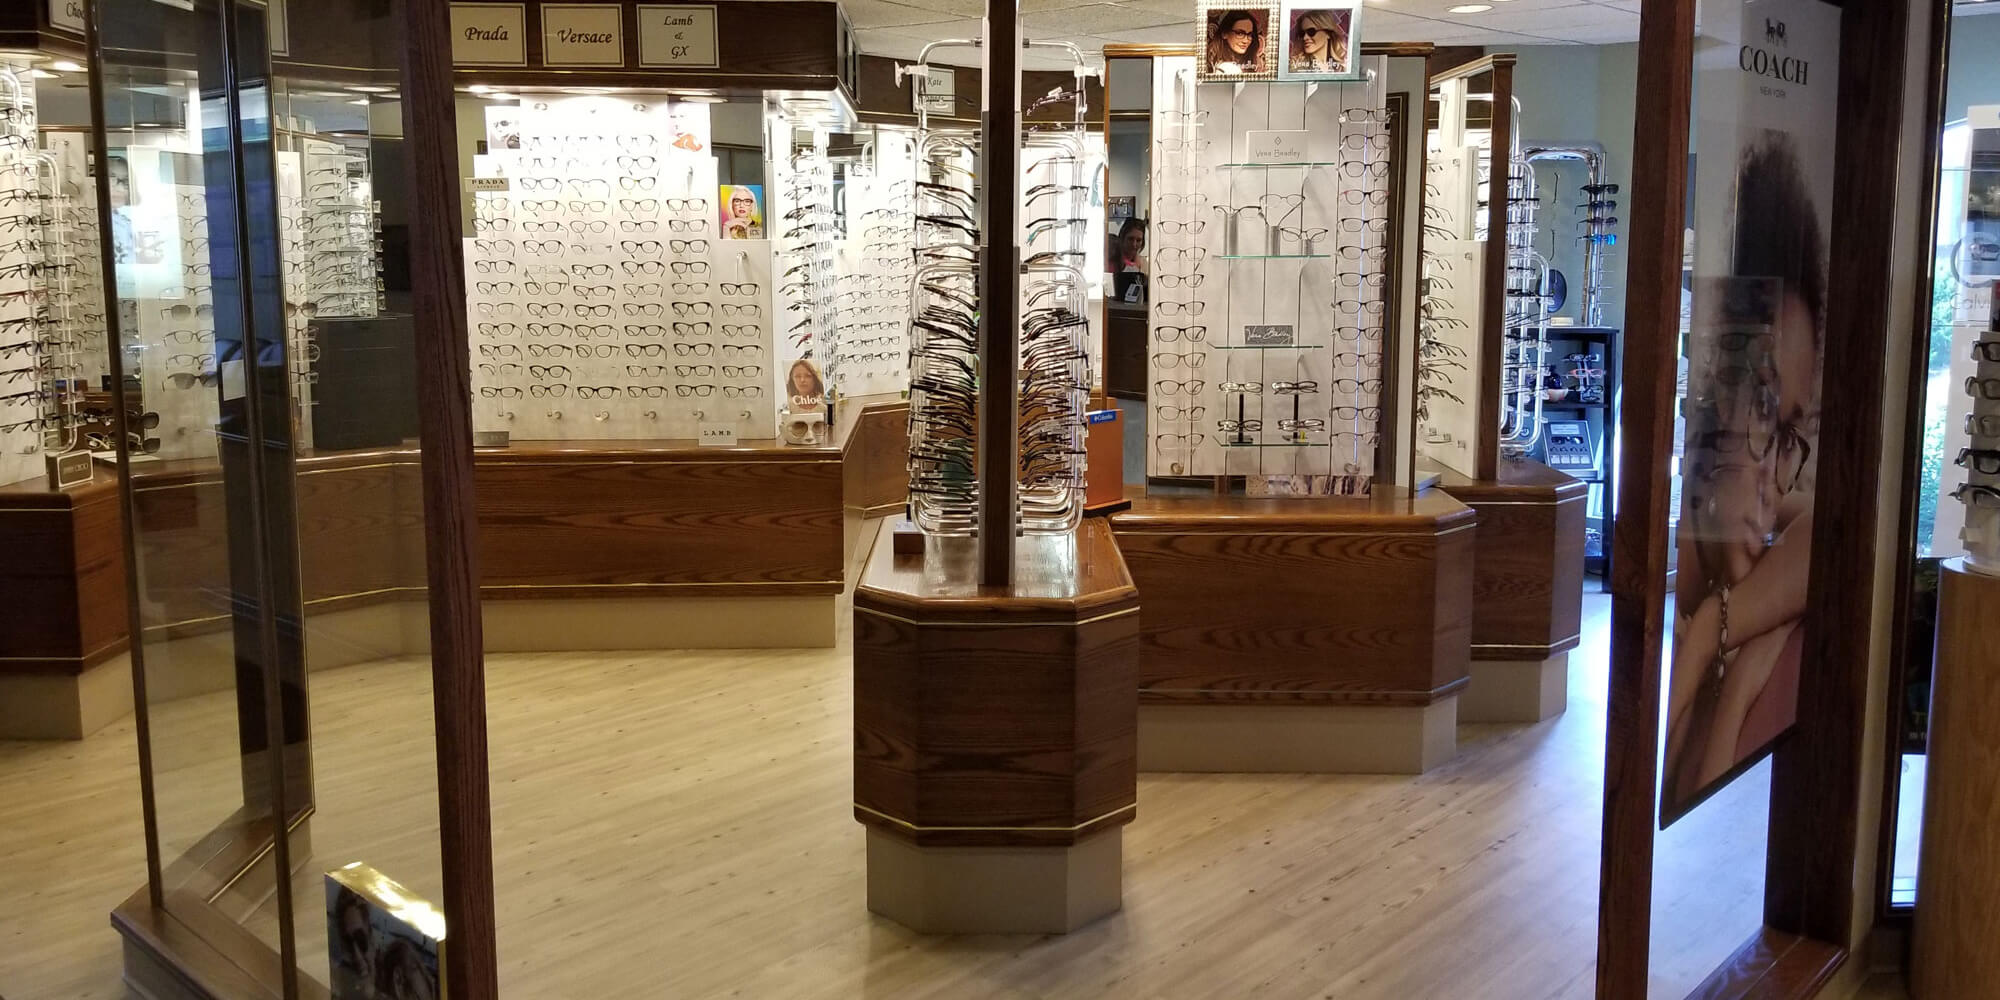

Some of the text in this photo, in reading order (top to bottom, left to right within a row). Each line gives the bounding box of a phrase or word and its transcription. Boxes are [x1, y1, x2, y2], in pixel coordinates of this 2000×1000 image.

[663, 15, 694, 26] Lamb
[464, 25, 509, 41] Prada
[557, 29, 612, 44] Versace
[671, 46, 689, 59] GX
[1739, 45, 1808, 86] COACH
